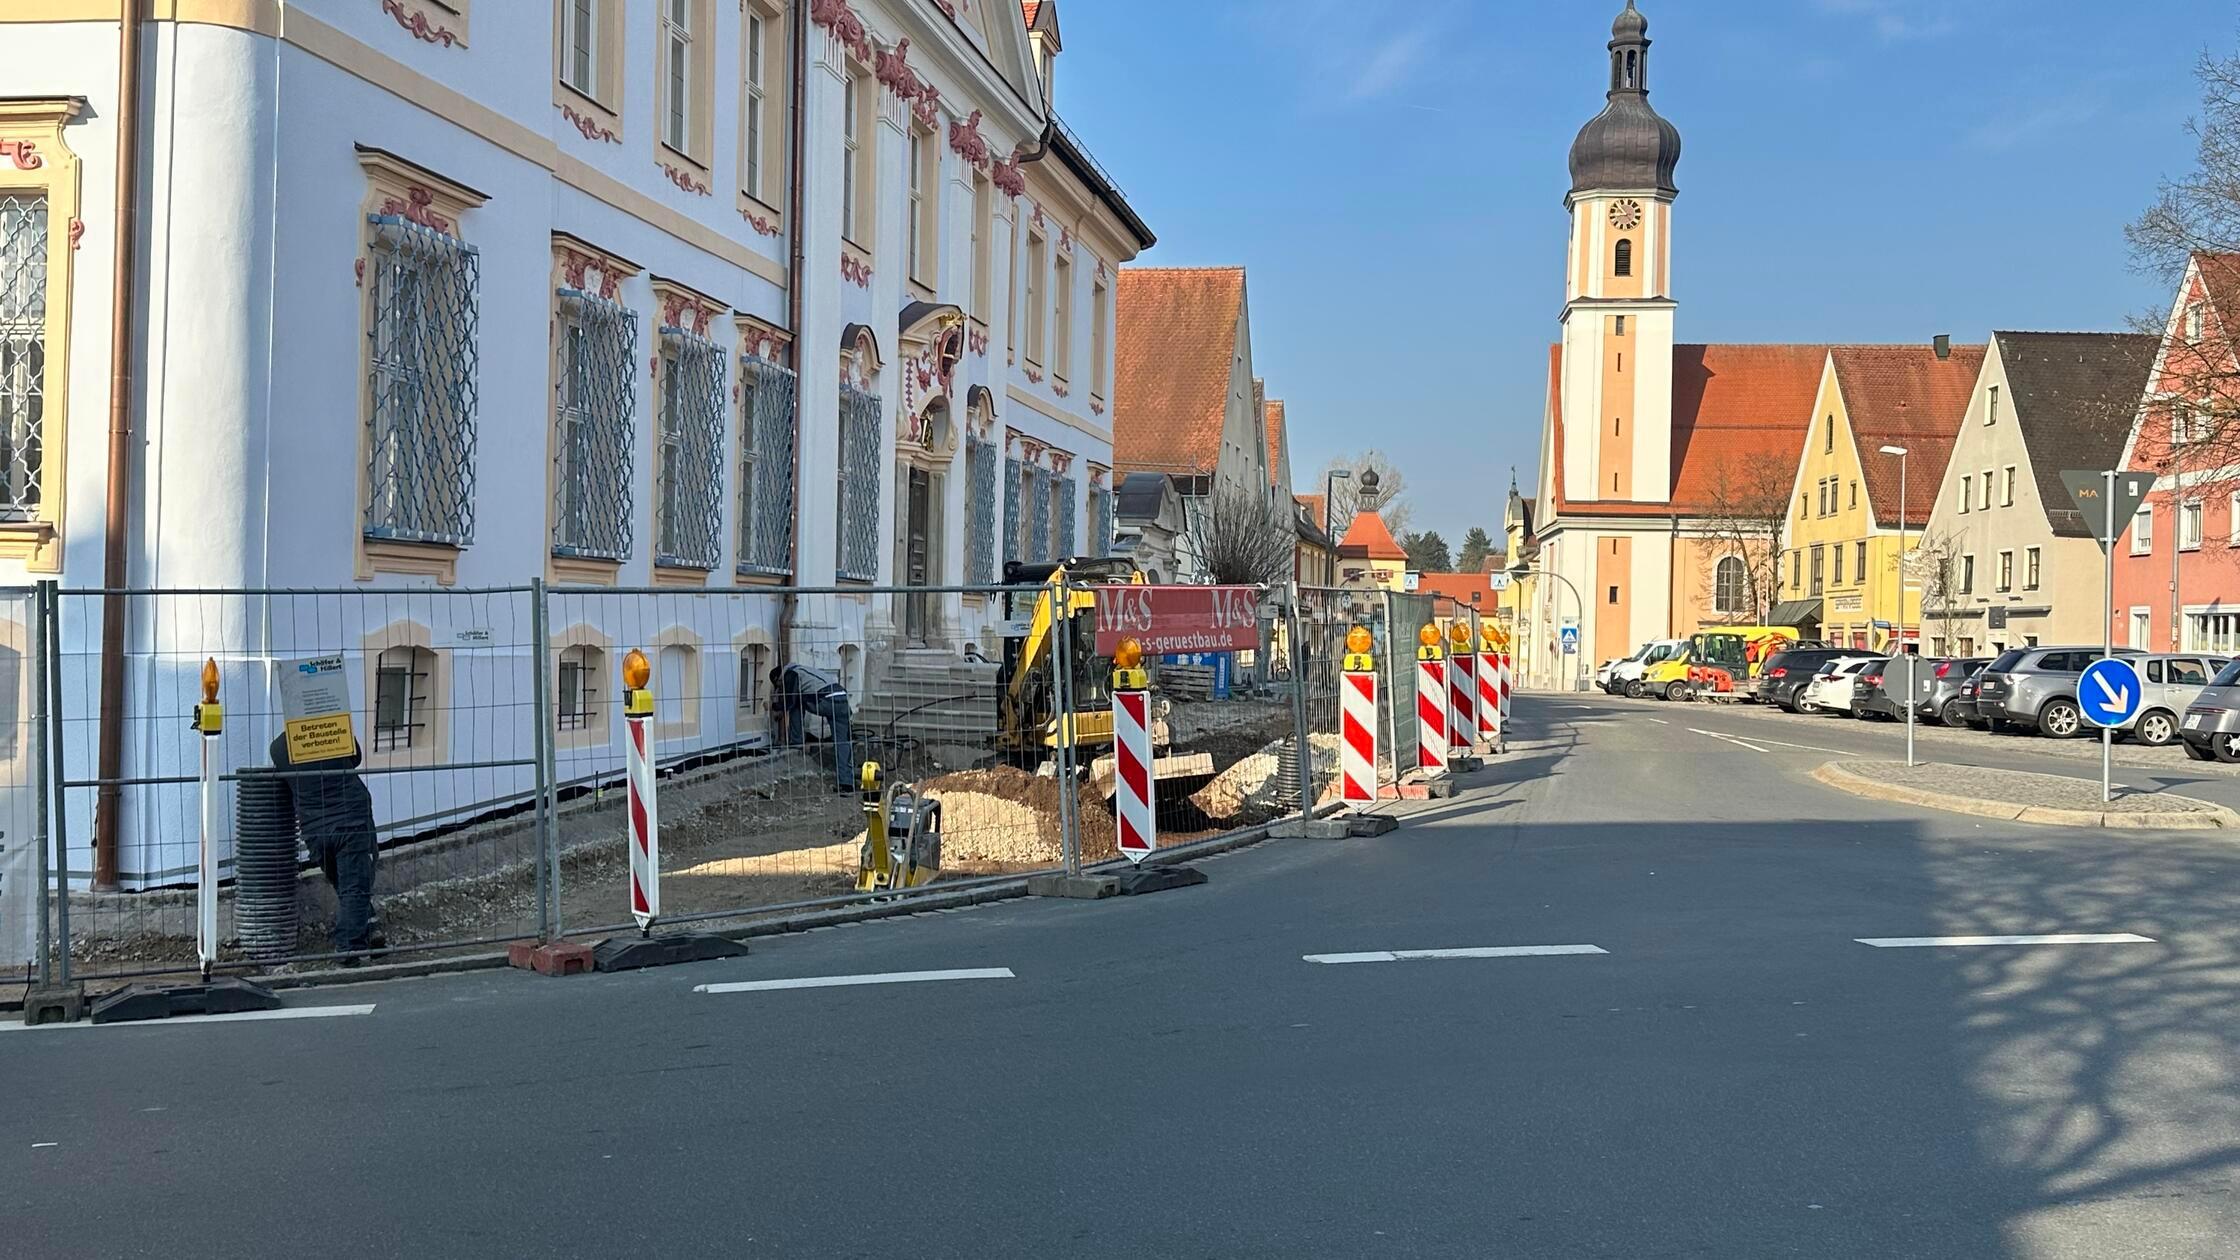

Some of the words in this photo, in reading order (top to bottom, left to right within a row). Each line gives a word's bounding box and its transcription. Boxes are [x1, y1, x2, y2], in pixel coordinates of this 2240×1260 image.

[2079, 489, 2099, 497] MA
[1098, 588, 1152, 633] M&S
[1210, 589, 1256, 629] M&S
[301, 722, 337, 732] Betreten
[309, 728, 347, 739] Baustelle
[302, 737, 340, 748] verboten!
